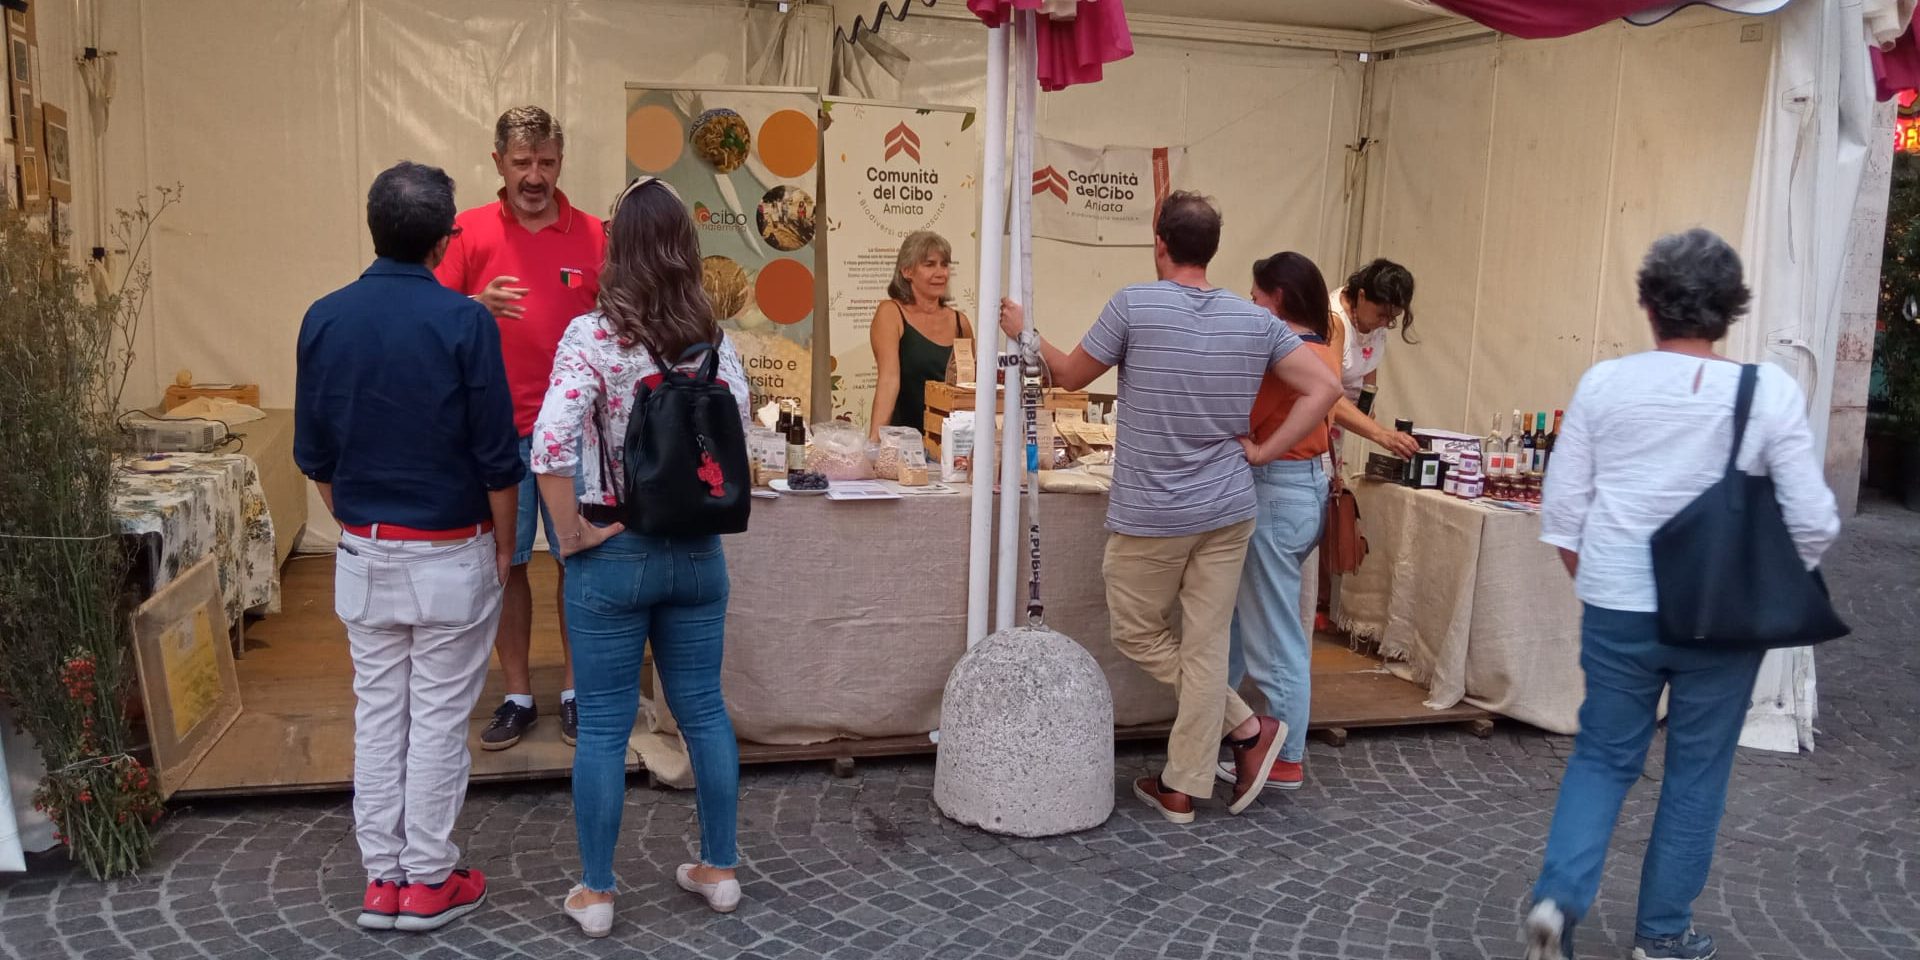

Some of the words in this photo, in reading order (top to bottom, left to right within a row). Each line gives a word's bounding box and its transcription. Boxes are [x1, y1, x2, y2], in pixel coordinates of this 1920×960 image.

[866, 167, 939, 184] Comunità
[1068, 170, 1138, 186] Comunità
[873, 185, 896, 200] del
[899, 186, 933, 201] Cibo
[1097, 186, 1134, 200] Cibo
[883, 203, 924, 215] Amiata
[749, 355, 783, 370] cibo
[787, 360, 797, 371] e
